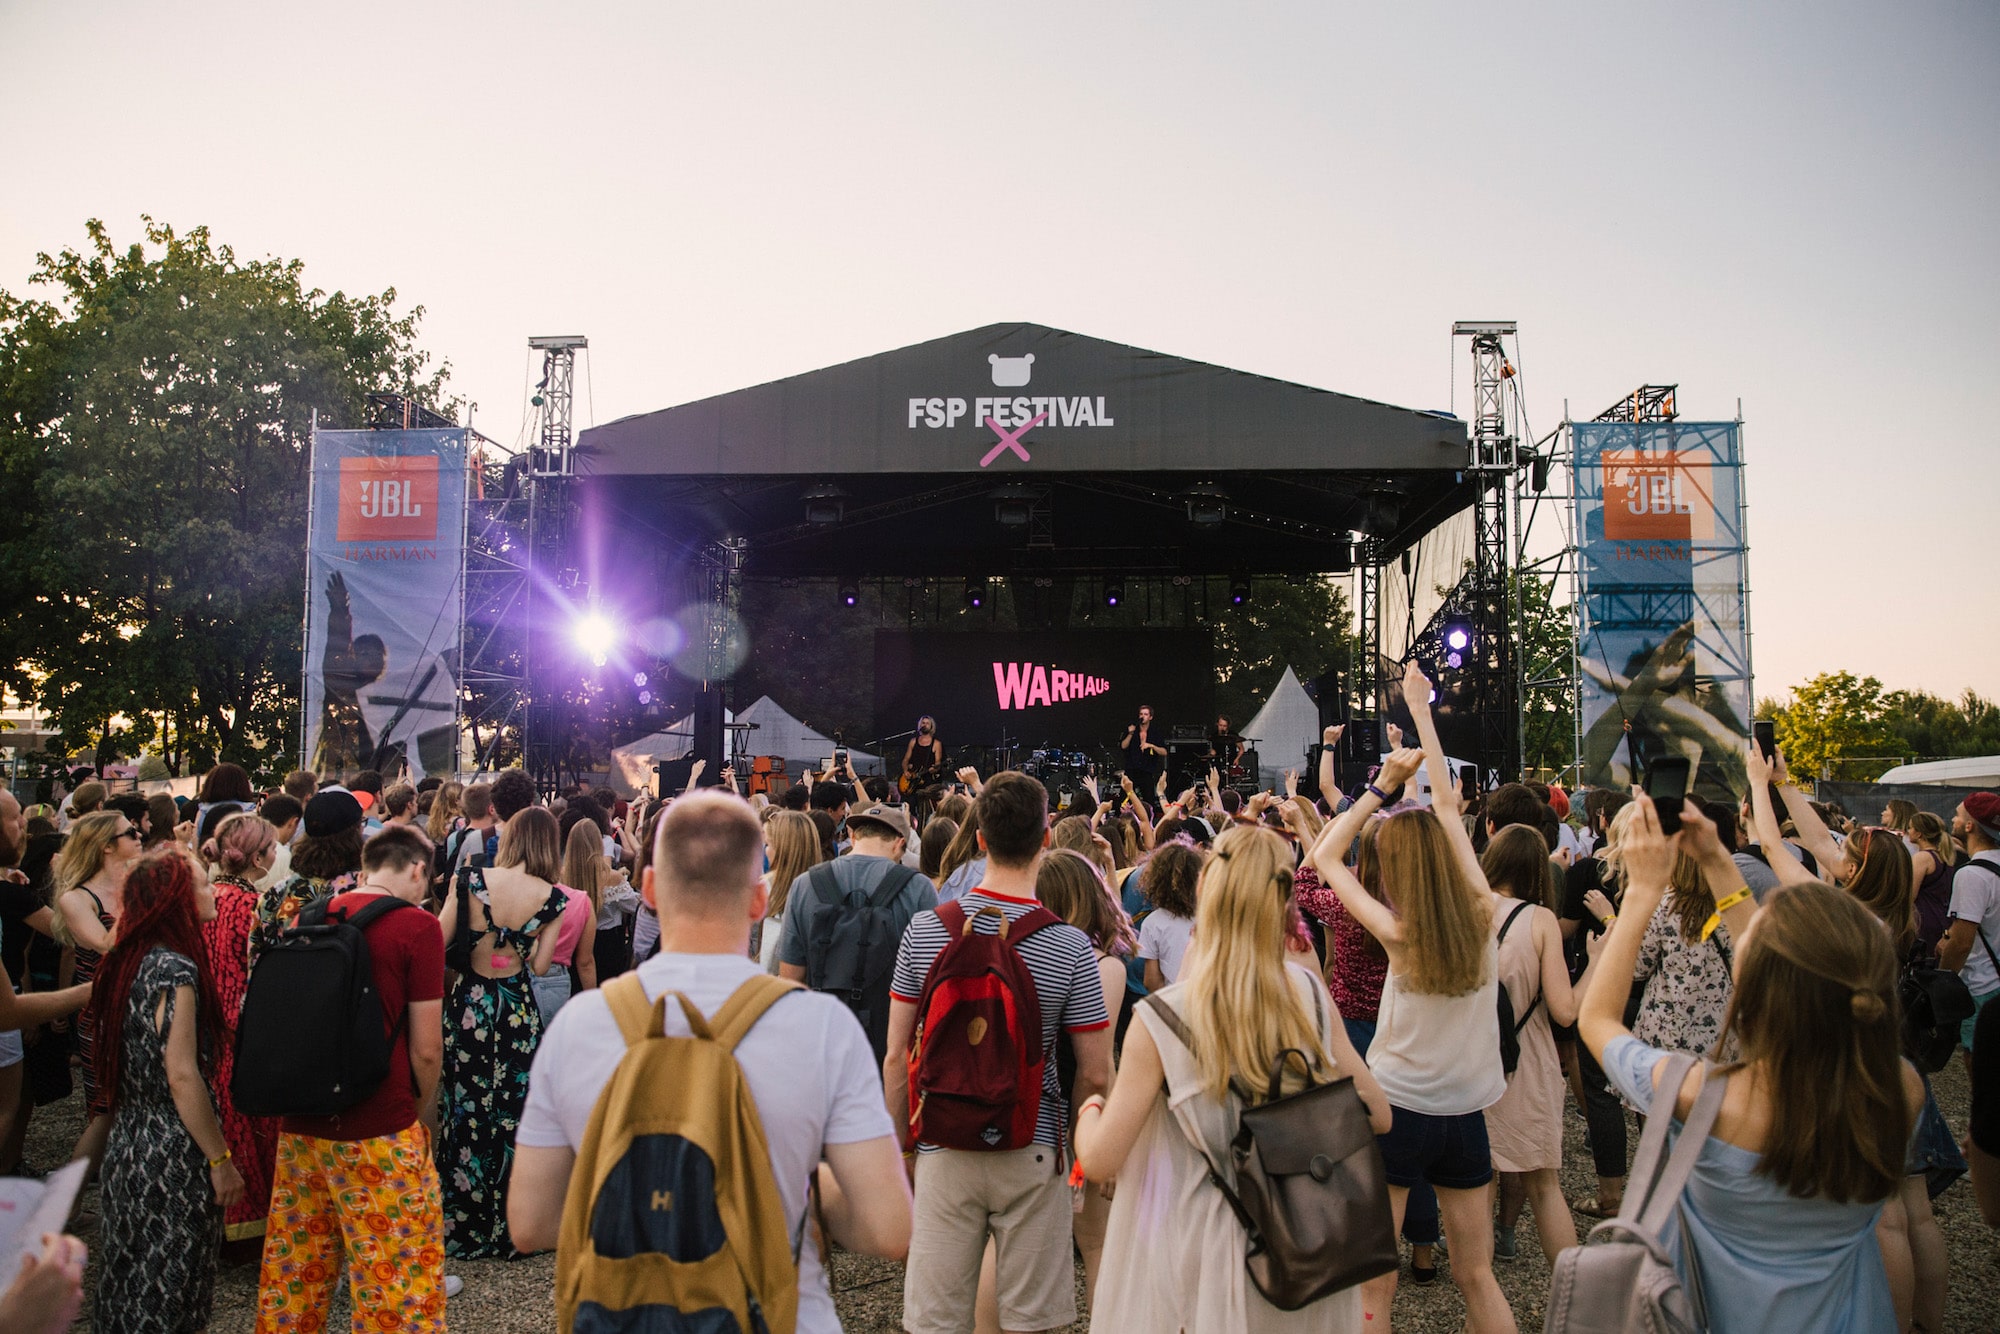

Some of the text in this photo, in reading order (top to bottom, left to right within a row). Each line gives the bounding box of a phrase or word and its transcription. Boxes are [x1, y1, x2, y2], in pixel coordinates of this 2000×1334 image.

[908, 396, 1114, 428] FSP FESTIVAL
[360, 480, 421, 518] JBL
[1627, 475, 1695, 515] JBL
[344, 545, 437, 562] HARMAN
[992, 662, 1110, 710] WARHAUS
